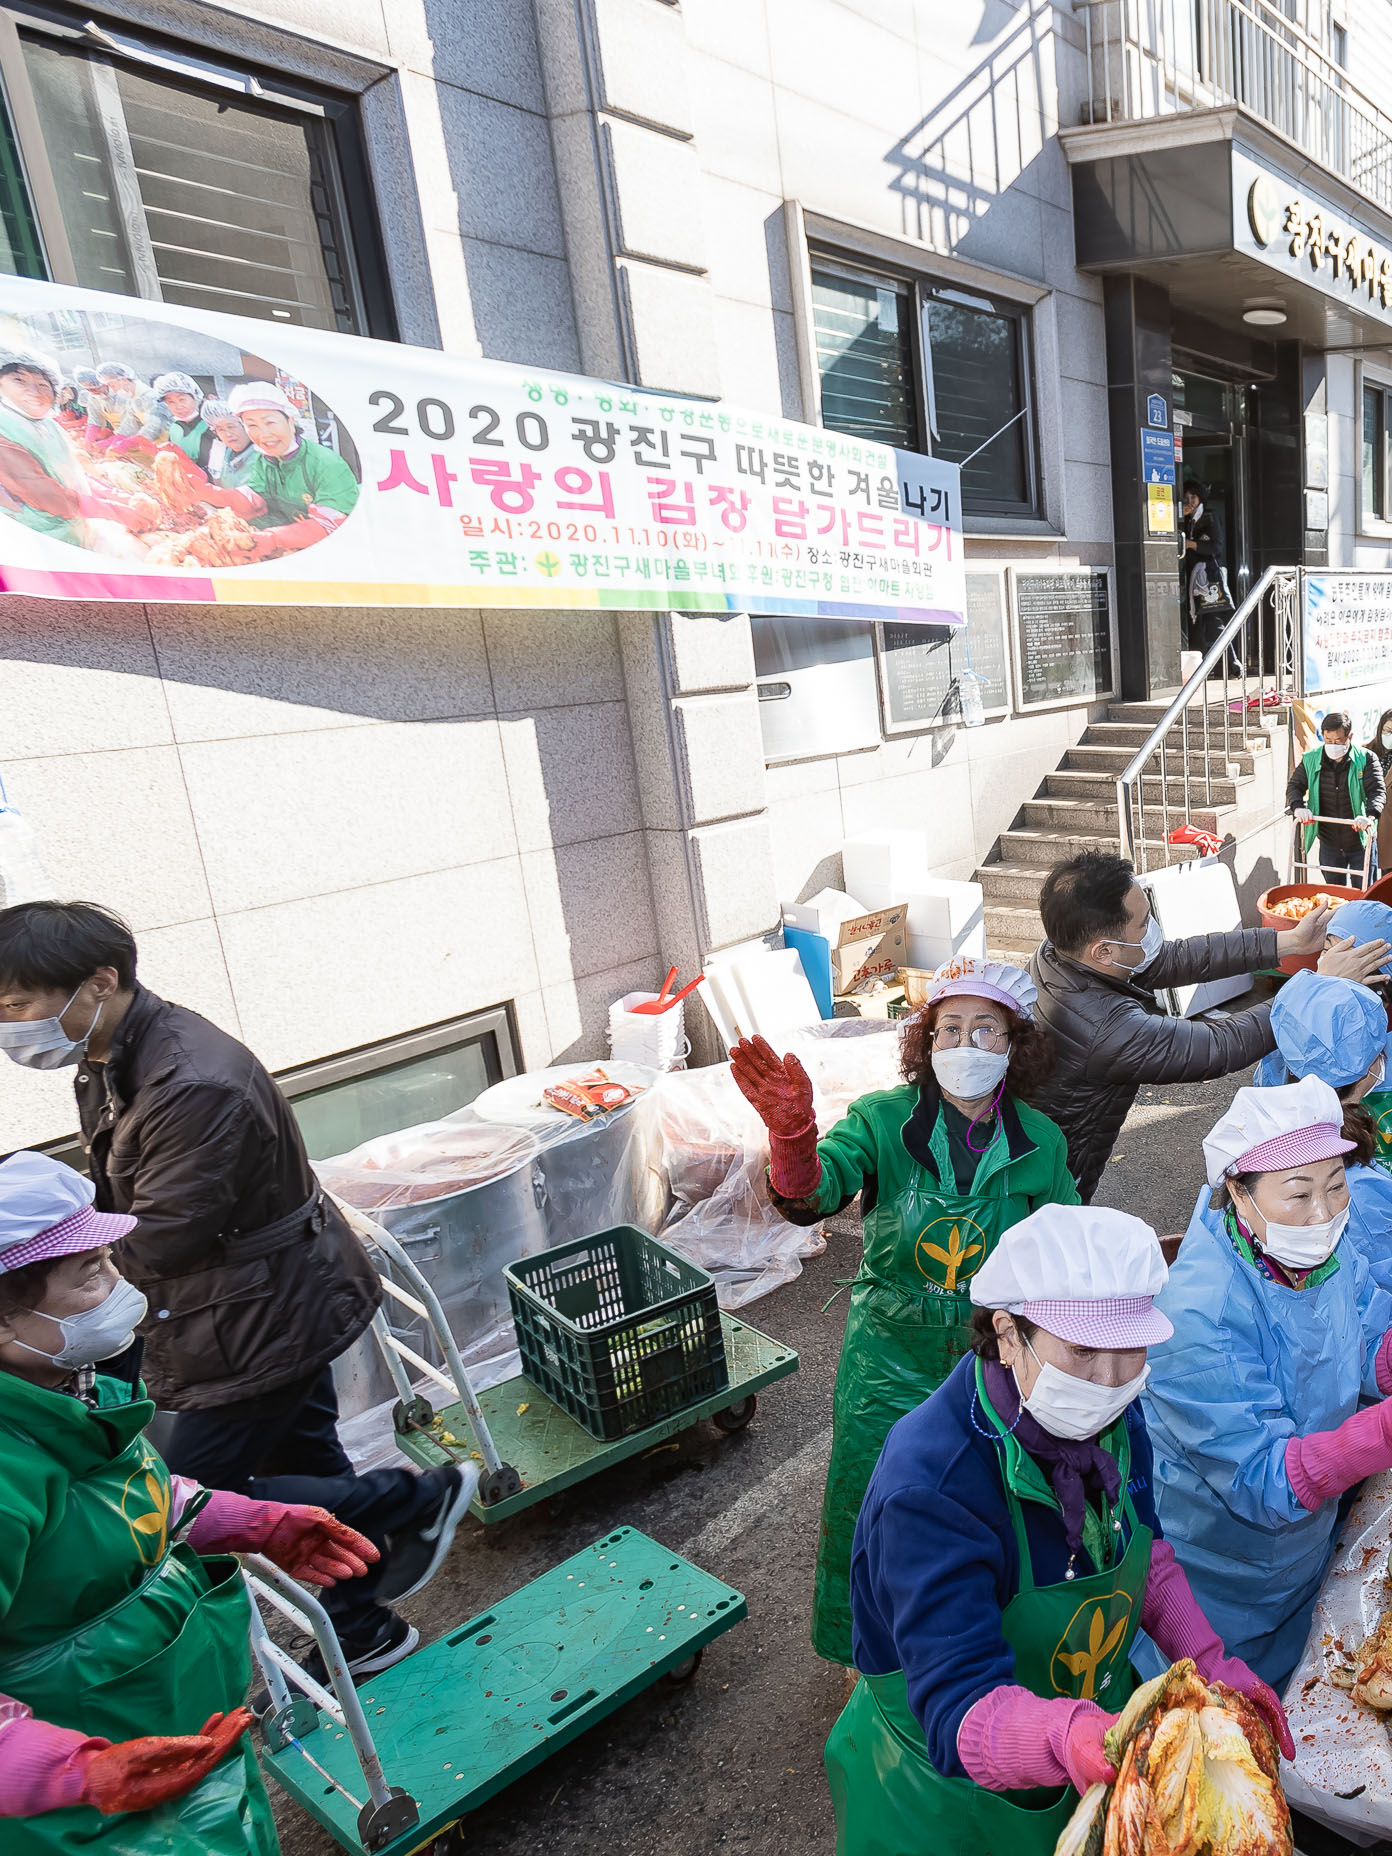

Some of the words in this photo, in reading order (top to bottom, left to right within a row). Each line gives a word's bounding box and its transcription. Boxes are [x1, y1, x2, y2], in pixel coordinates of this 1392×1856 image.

[369, 390, 549, 451] 2020
[571, 417, 717, 475] 광진구
[735, 443, 835, 498] 따뜻한
[847, 468, 950, 522] 겨울나기
[1153, 409, 1162, 422] 23
[377, 449, 616, 519] 사랑의
[647, 476, 752, 533] 김장
[773, 495, 953, 562] 담가드리기
